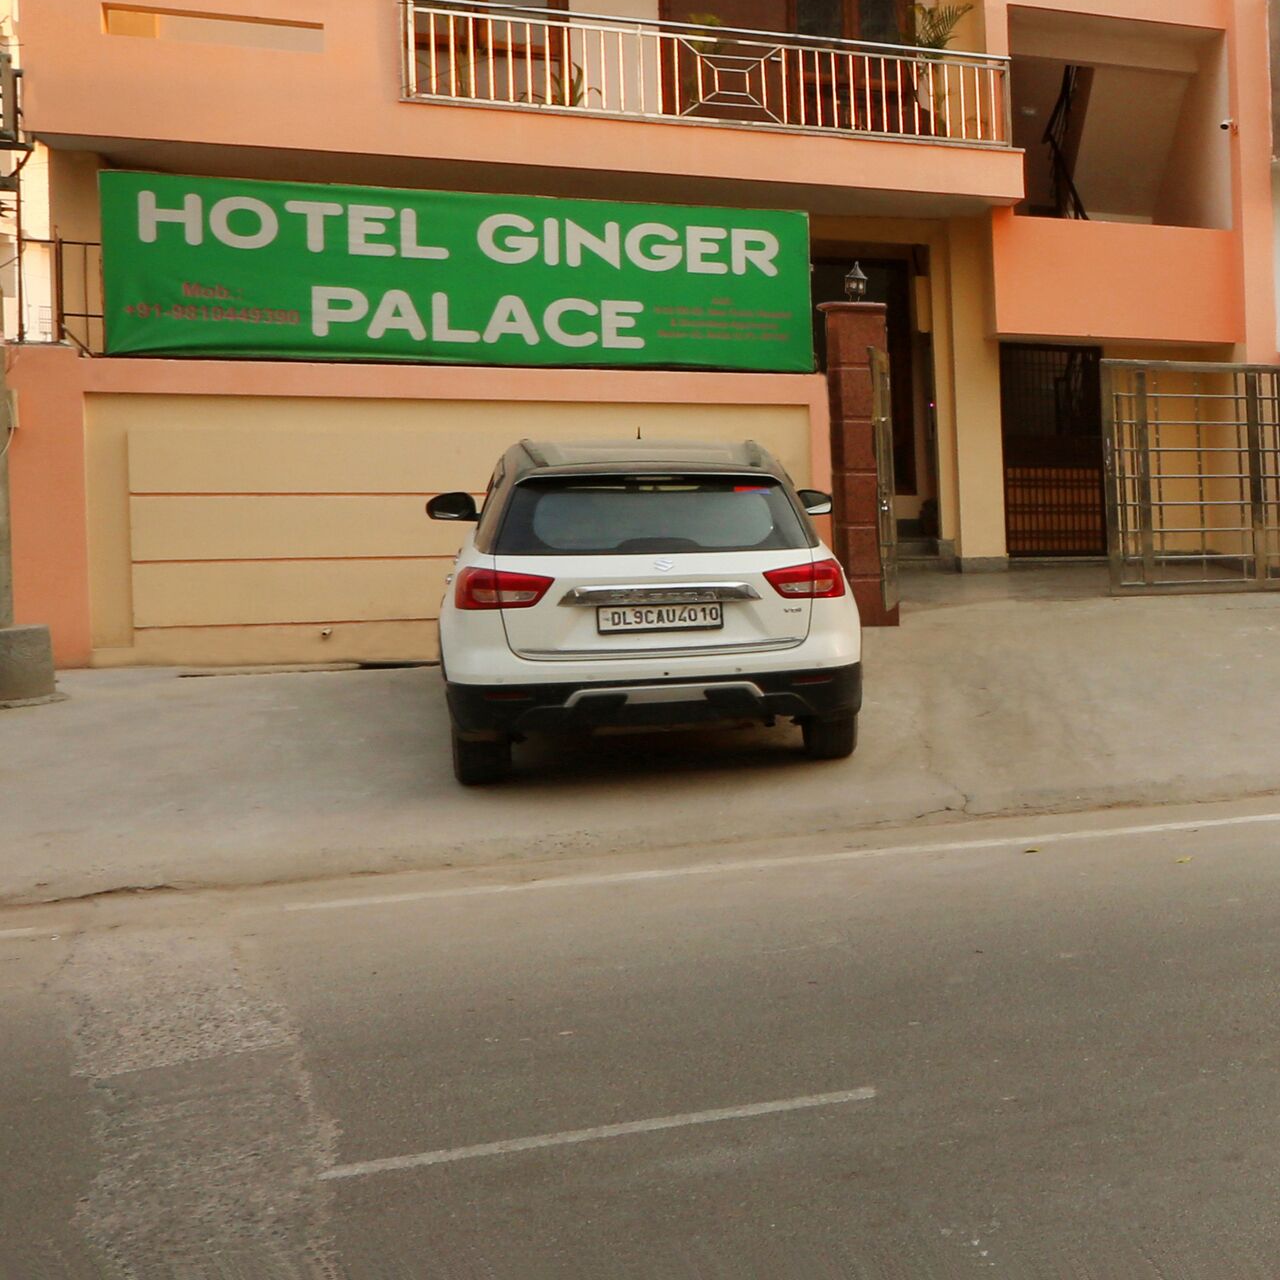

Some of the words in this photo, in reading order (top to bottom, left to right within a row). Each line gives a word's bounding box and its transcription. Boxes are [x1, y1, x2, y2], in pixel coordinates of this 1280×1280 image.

[138, 190, 449, 260] HOTEL
[476, 213, 780, 278] GINGER
[311, 285, 646, 350] PALACE
[610, 606, 719, 626] DL9CAU4010
